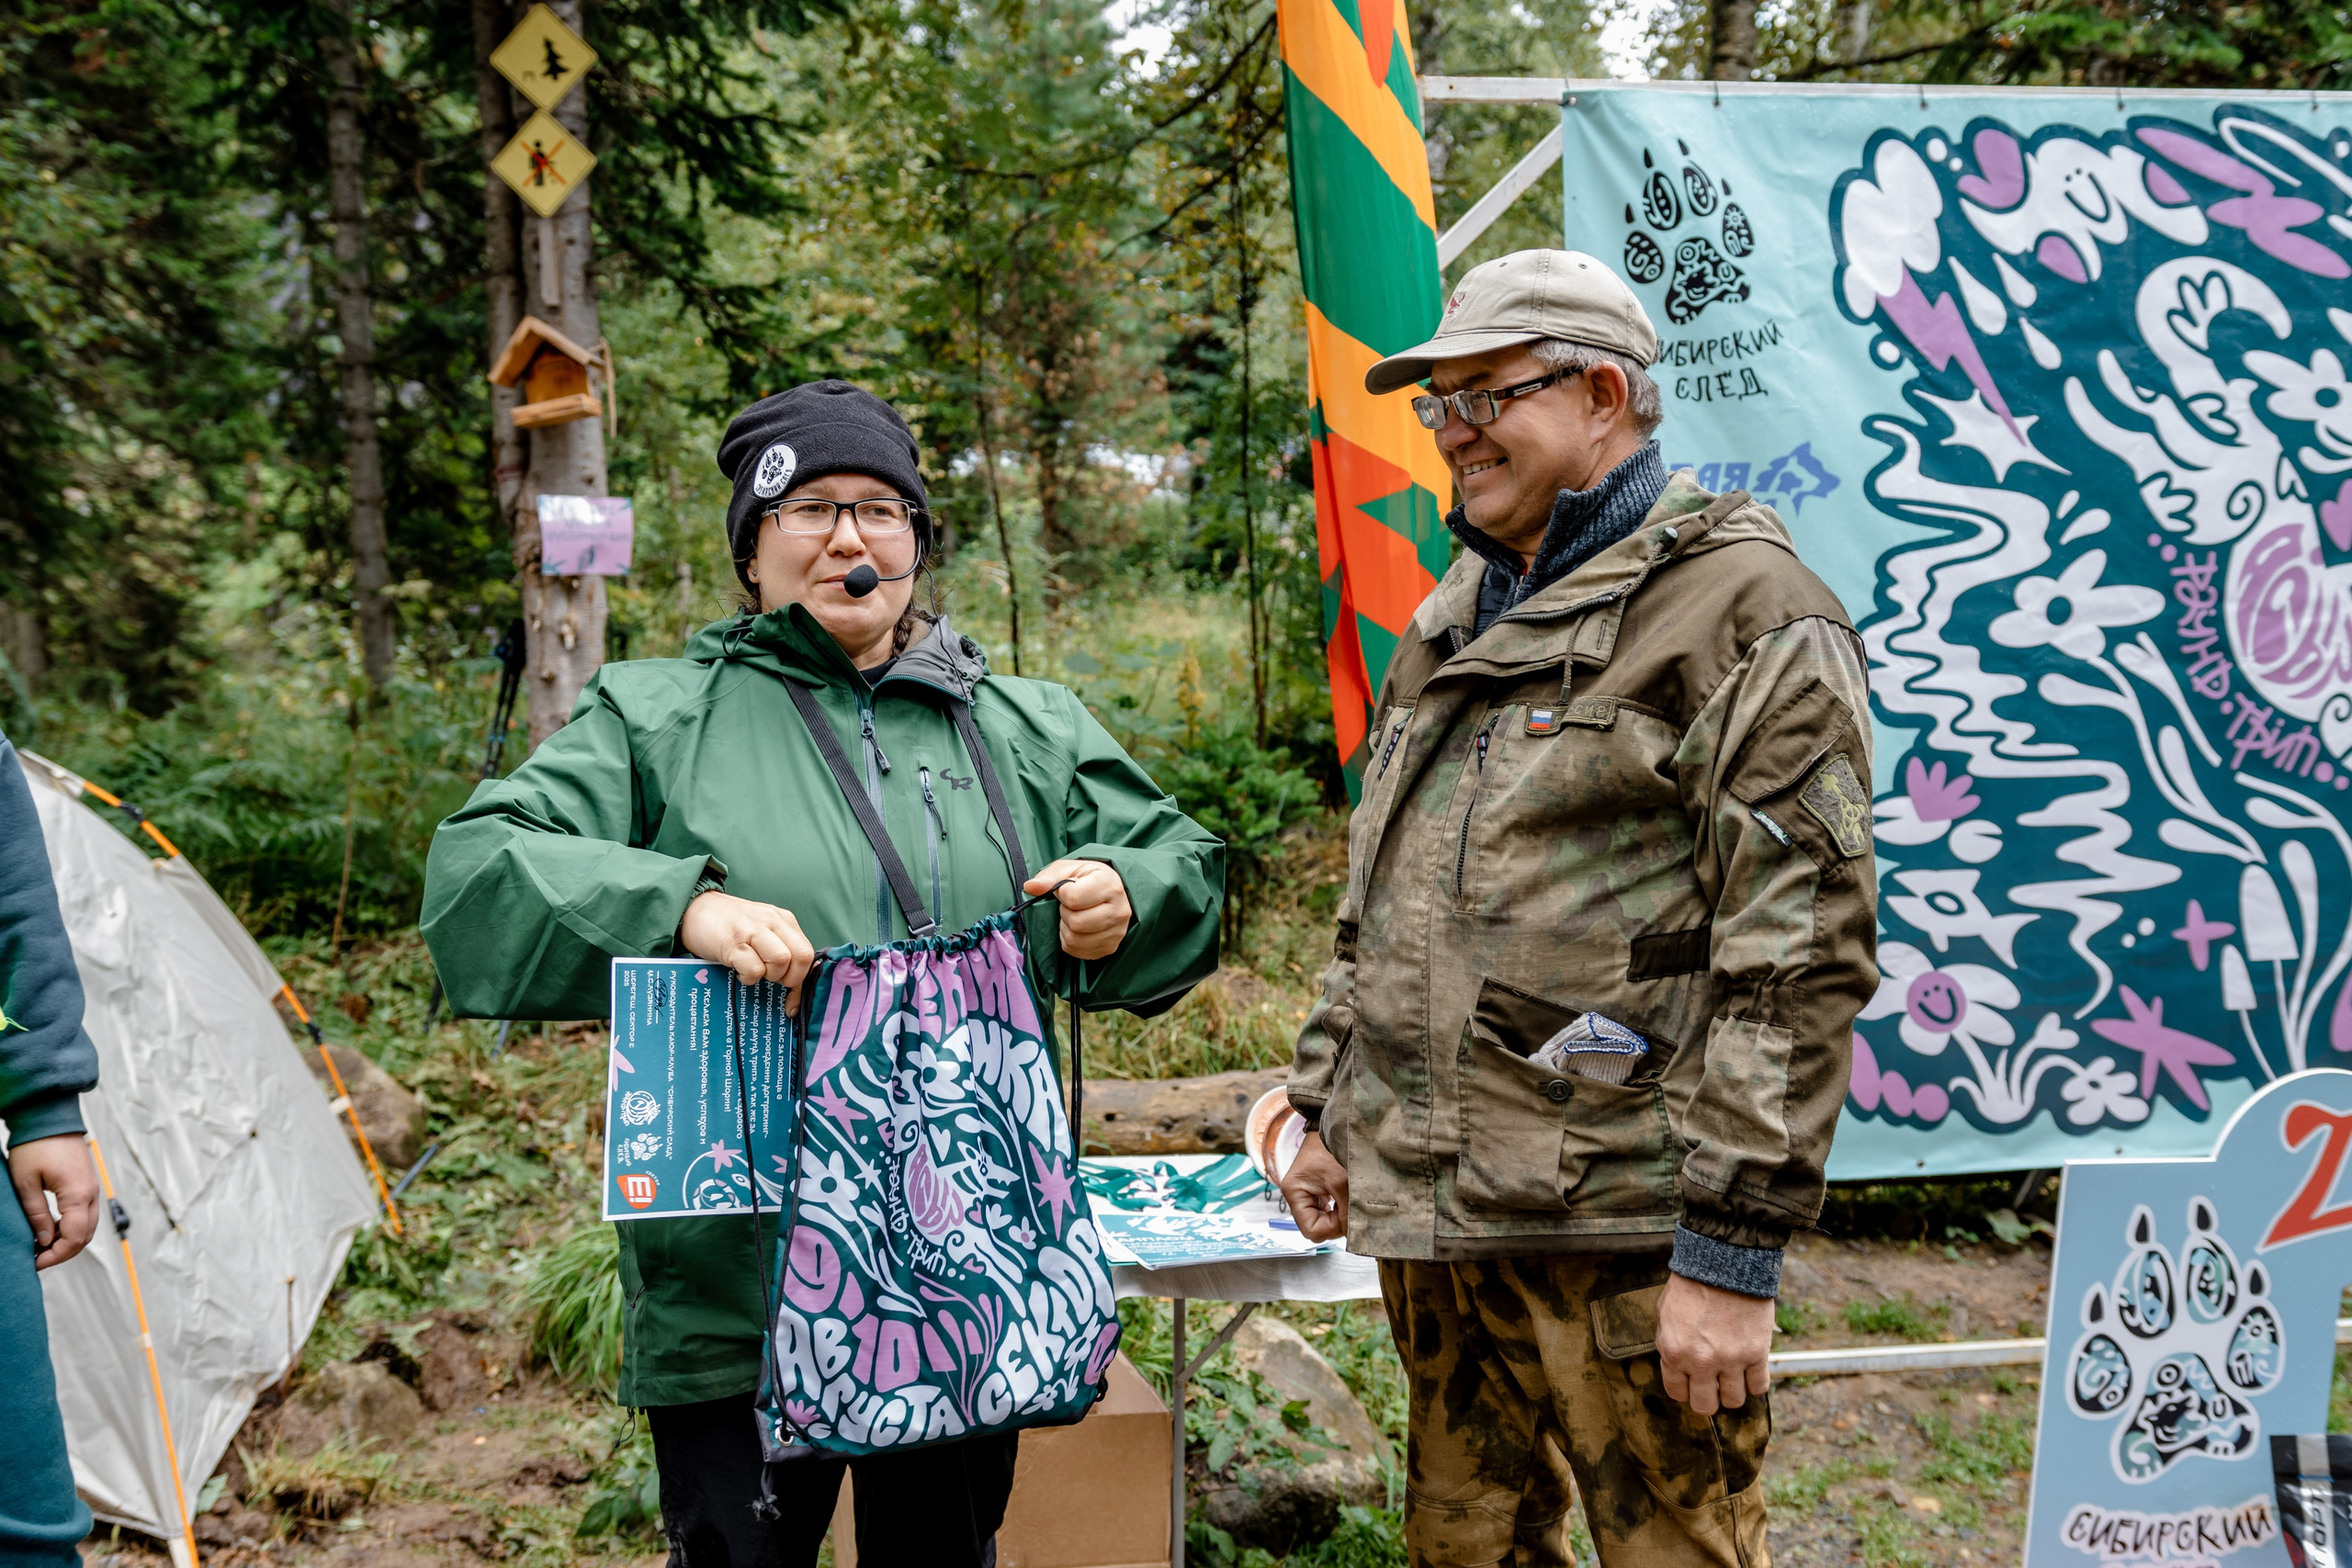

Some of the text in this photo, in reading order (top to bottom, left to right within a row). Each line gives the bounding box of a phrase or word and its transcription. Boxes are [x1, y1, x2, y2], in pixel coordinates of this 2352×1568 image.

[1659, 319, 1783, 367] ИБИРСКИЙ
[688, 988, 697, 1050] процветания!
[765, 981, 774, 1021] дготовке
[723, 1045, 733, 1077] Горной
[750, 1029, 758, 1055] раунд
[763, 1031, 771, 1083] проведении
[778, 1044, 784, 1054] за
[775, 1056, 784, 1092] помощь
[722, 1078, 731, 1111] Шории!
[761, 1085, 770, 1138] догтрекинг-
[697, 1100, 707, 1136] успехов
[751, 1110, 755, 1122] же
[977, 1218, 1115, 1426] СЕКТОР
[853, 1313, 920, 1393] 10
[2069, 1503, 2273, 1558] СИБИРСКИЙ
